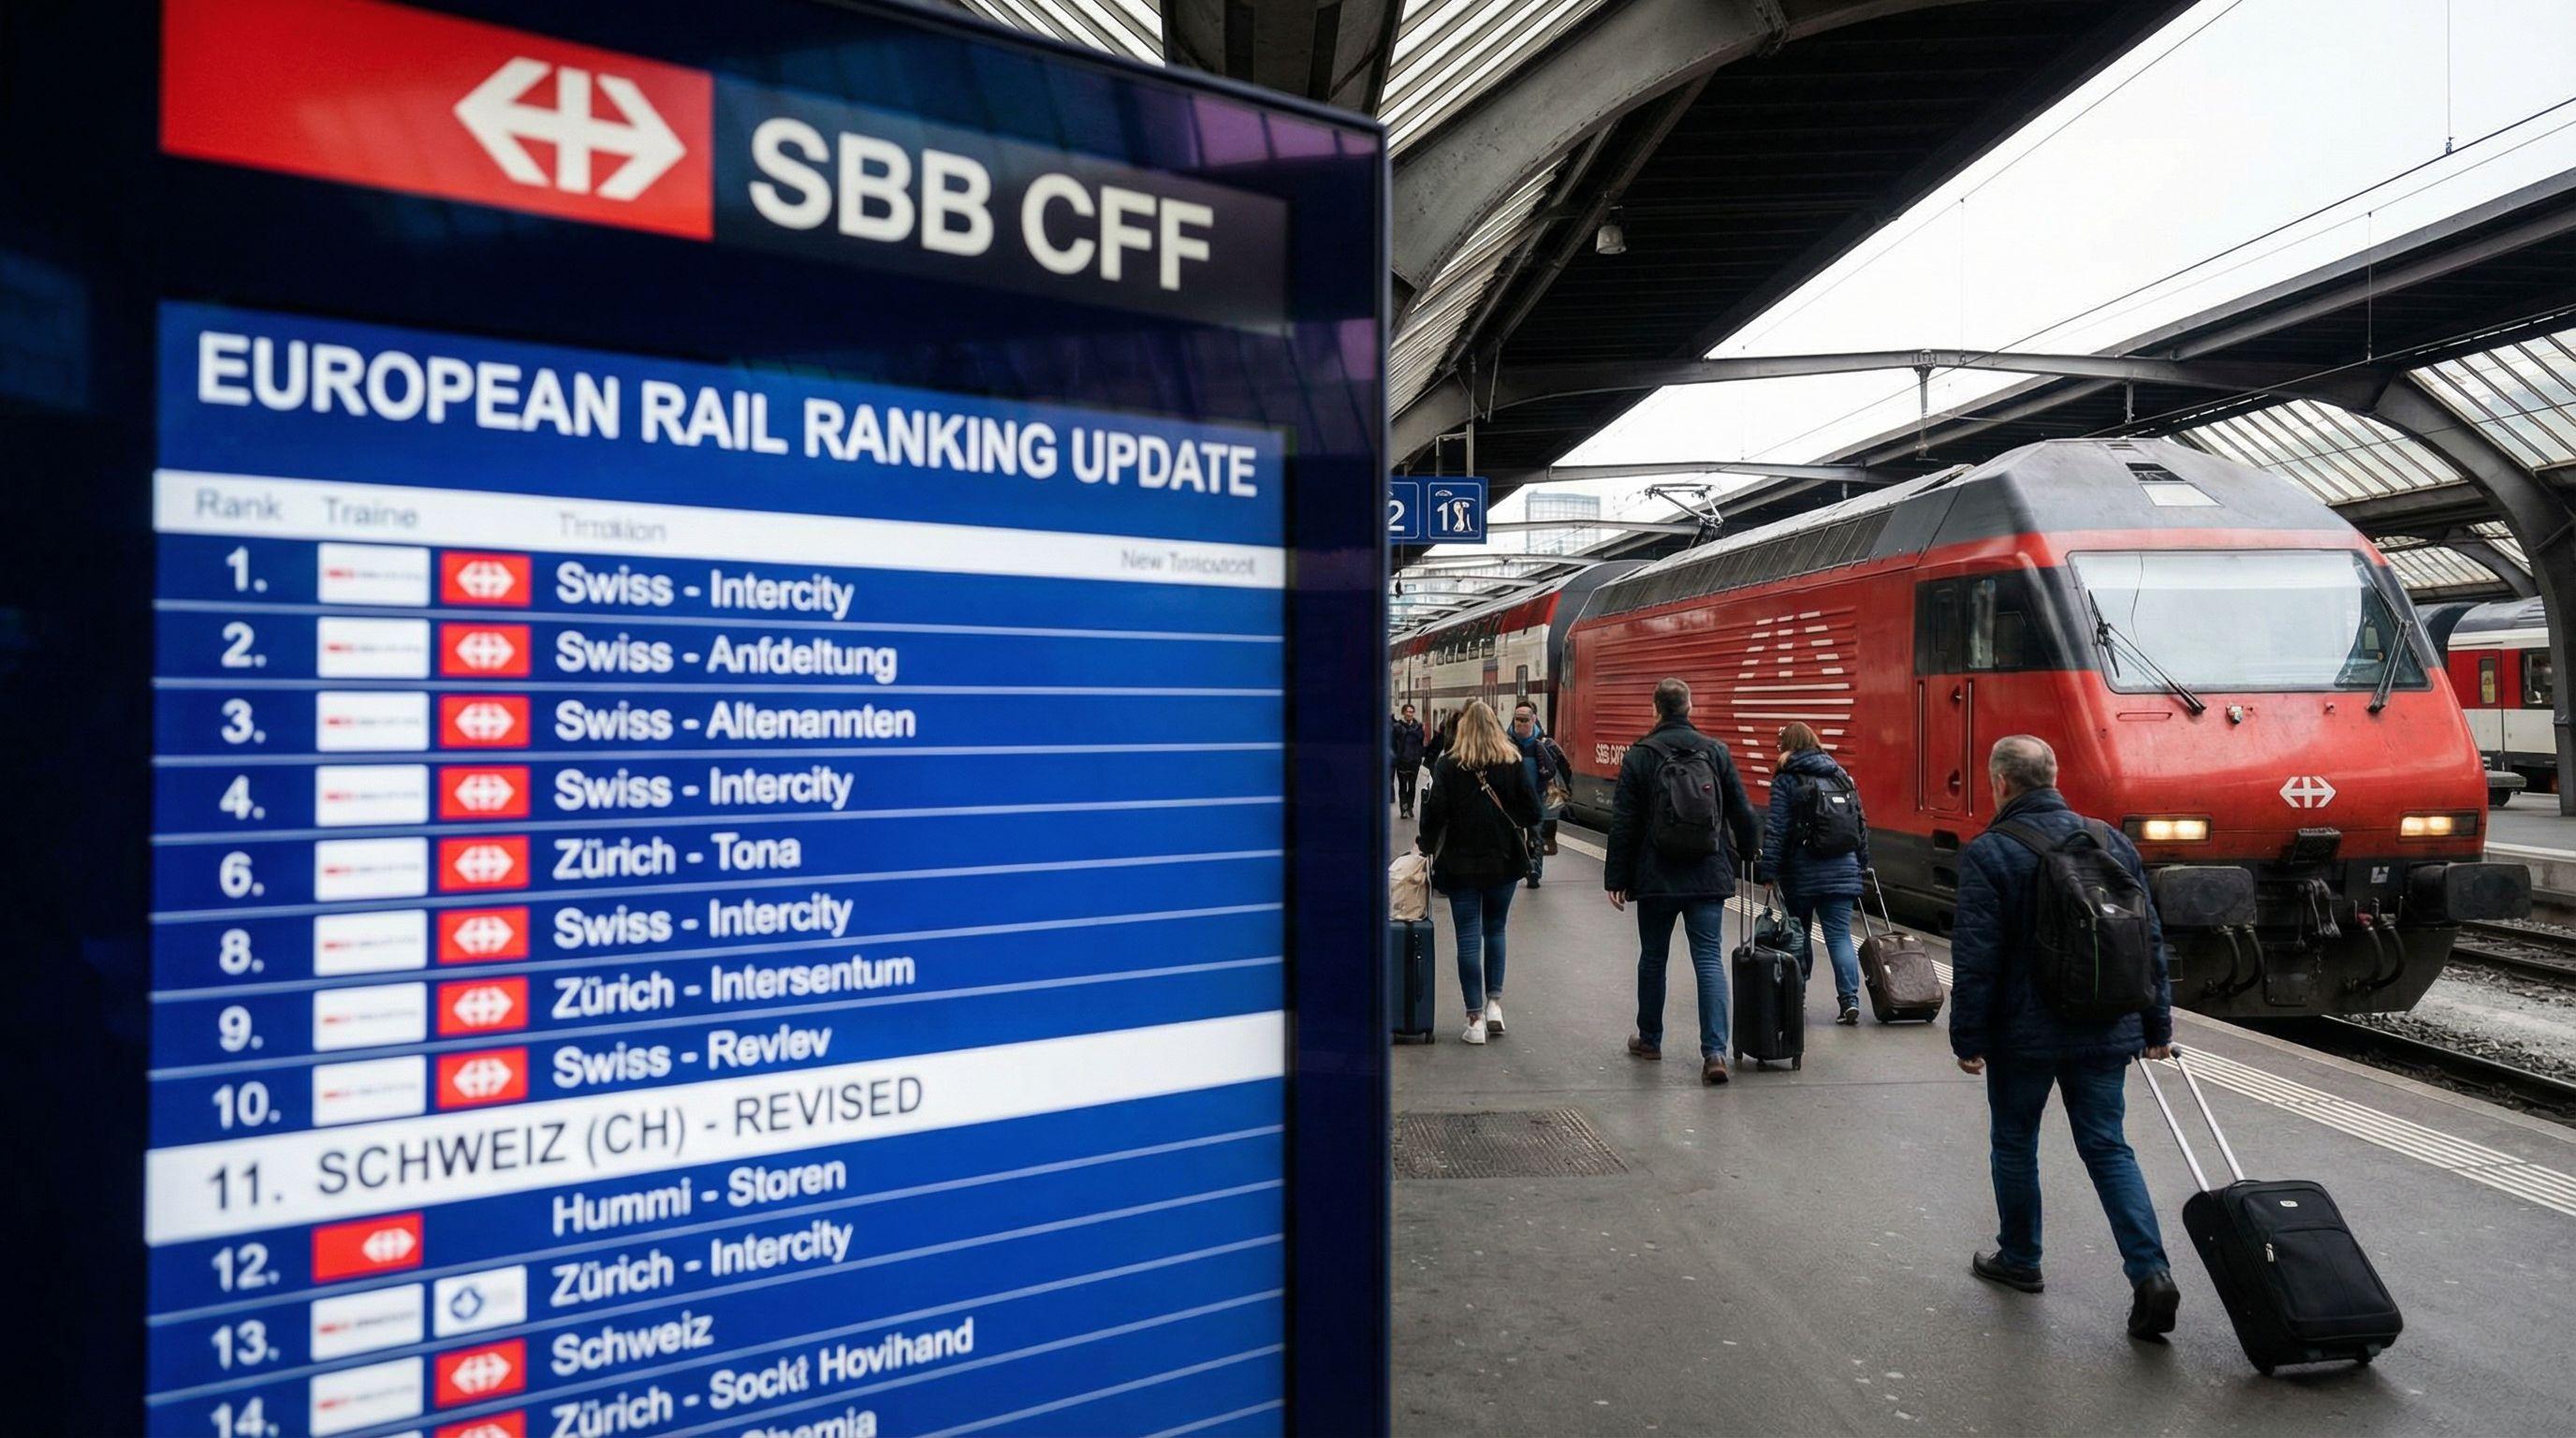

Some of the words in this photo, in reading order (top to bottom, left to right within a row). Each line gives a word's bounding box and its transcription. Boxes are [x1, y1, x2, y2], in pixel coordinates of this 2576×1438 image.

[750, 118, 994, 256] SBB
[1021, 173, 1213, 290] CFF
[198, 331, 620, 439] EUROPEAN
[641, 380, 788, 454] RAIL
[804, 398, 1058, 479] RANKING
[1072, 427, 1257, 497] UPDATE
[194, 485, 284, 521] Rank
[1389, 500, 1404, 531] 2
[227, 547, 267, 592] 1.
[556, 561, 674, 607] Swiss
[683, 585, 701, 597] -
[710, 569, 855, 621] Intercity
[221, 621, 267, 668] 2.
[556, 630, 674, 673] Swiss
[681, 652, 700, 664] -
[221, 697, 266, 744] 3.
[555, 699, 673, 741] Swiss
[681, 718, 701, 731] -
[219, 774, 265, 820] 4.
[554, 769, 673, 811] Swiss
[681, 785, 700, 798] -
[710, 765, 854, 811] Intercity
[219, 851, 265, 899] 6.
[552, 836, 676, 880] Zürich
[685, 851, 704, 864] -
[710, 831, 801, 871] Tona
[218, 928, 265, 975] 8.
[553, 905, 673, 949] Swiss
[681, 917, 699, 931] -
[709, 892, 854, 938] Intercity
[218, 1005, 263, 1052] 9.
[551, 971, 676, 1020] Zürich
[682, 984, 702, 997] -
[710, 955, 915, 1004] Intersentum
[212, 1080, 281, 1128] 10.
[553, 1042, 672, 1089] Swiss
[680, 1050, 699, 1064] -
[209, 1161, 283, 1212] 11.
[316, 1121, 566, 1196] SCHWEIZ
[586, 1107, 687, 1169] (CH)
[703, 1121, 719, 1133] -
[734, 1076, 924, 1137] REVISED
[212, 1242, 279, 1290] 12.
[552, 1177, 693, 1237] Hummi
[700, 1189, 720, 1203] -
[726, 1160, 847, 1208] Storen
[212, 1319, 278, 1368] 13.
[550, 1250, 674, 1307] Zürich
[683, 1259, 702, 1272] -
[710, 1220, 854, 1276] Intercity
[212, 1397, 277, 1438] 14.
[550, 1311, 714, 1377] Schweiz
[551, 1387, 673, 1438] Zürich
[682, 1394, 700, 1407] -
[739, 1406, 878, 1438] mia
